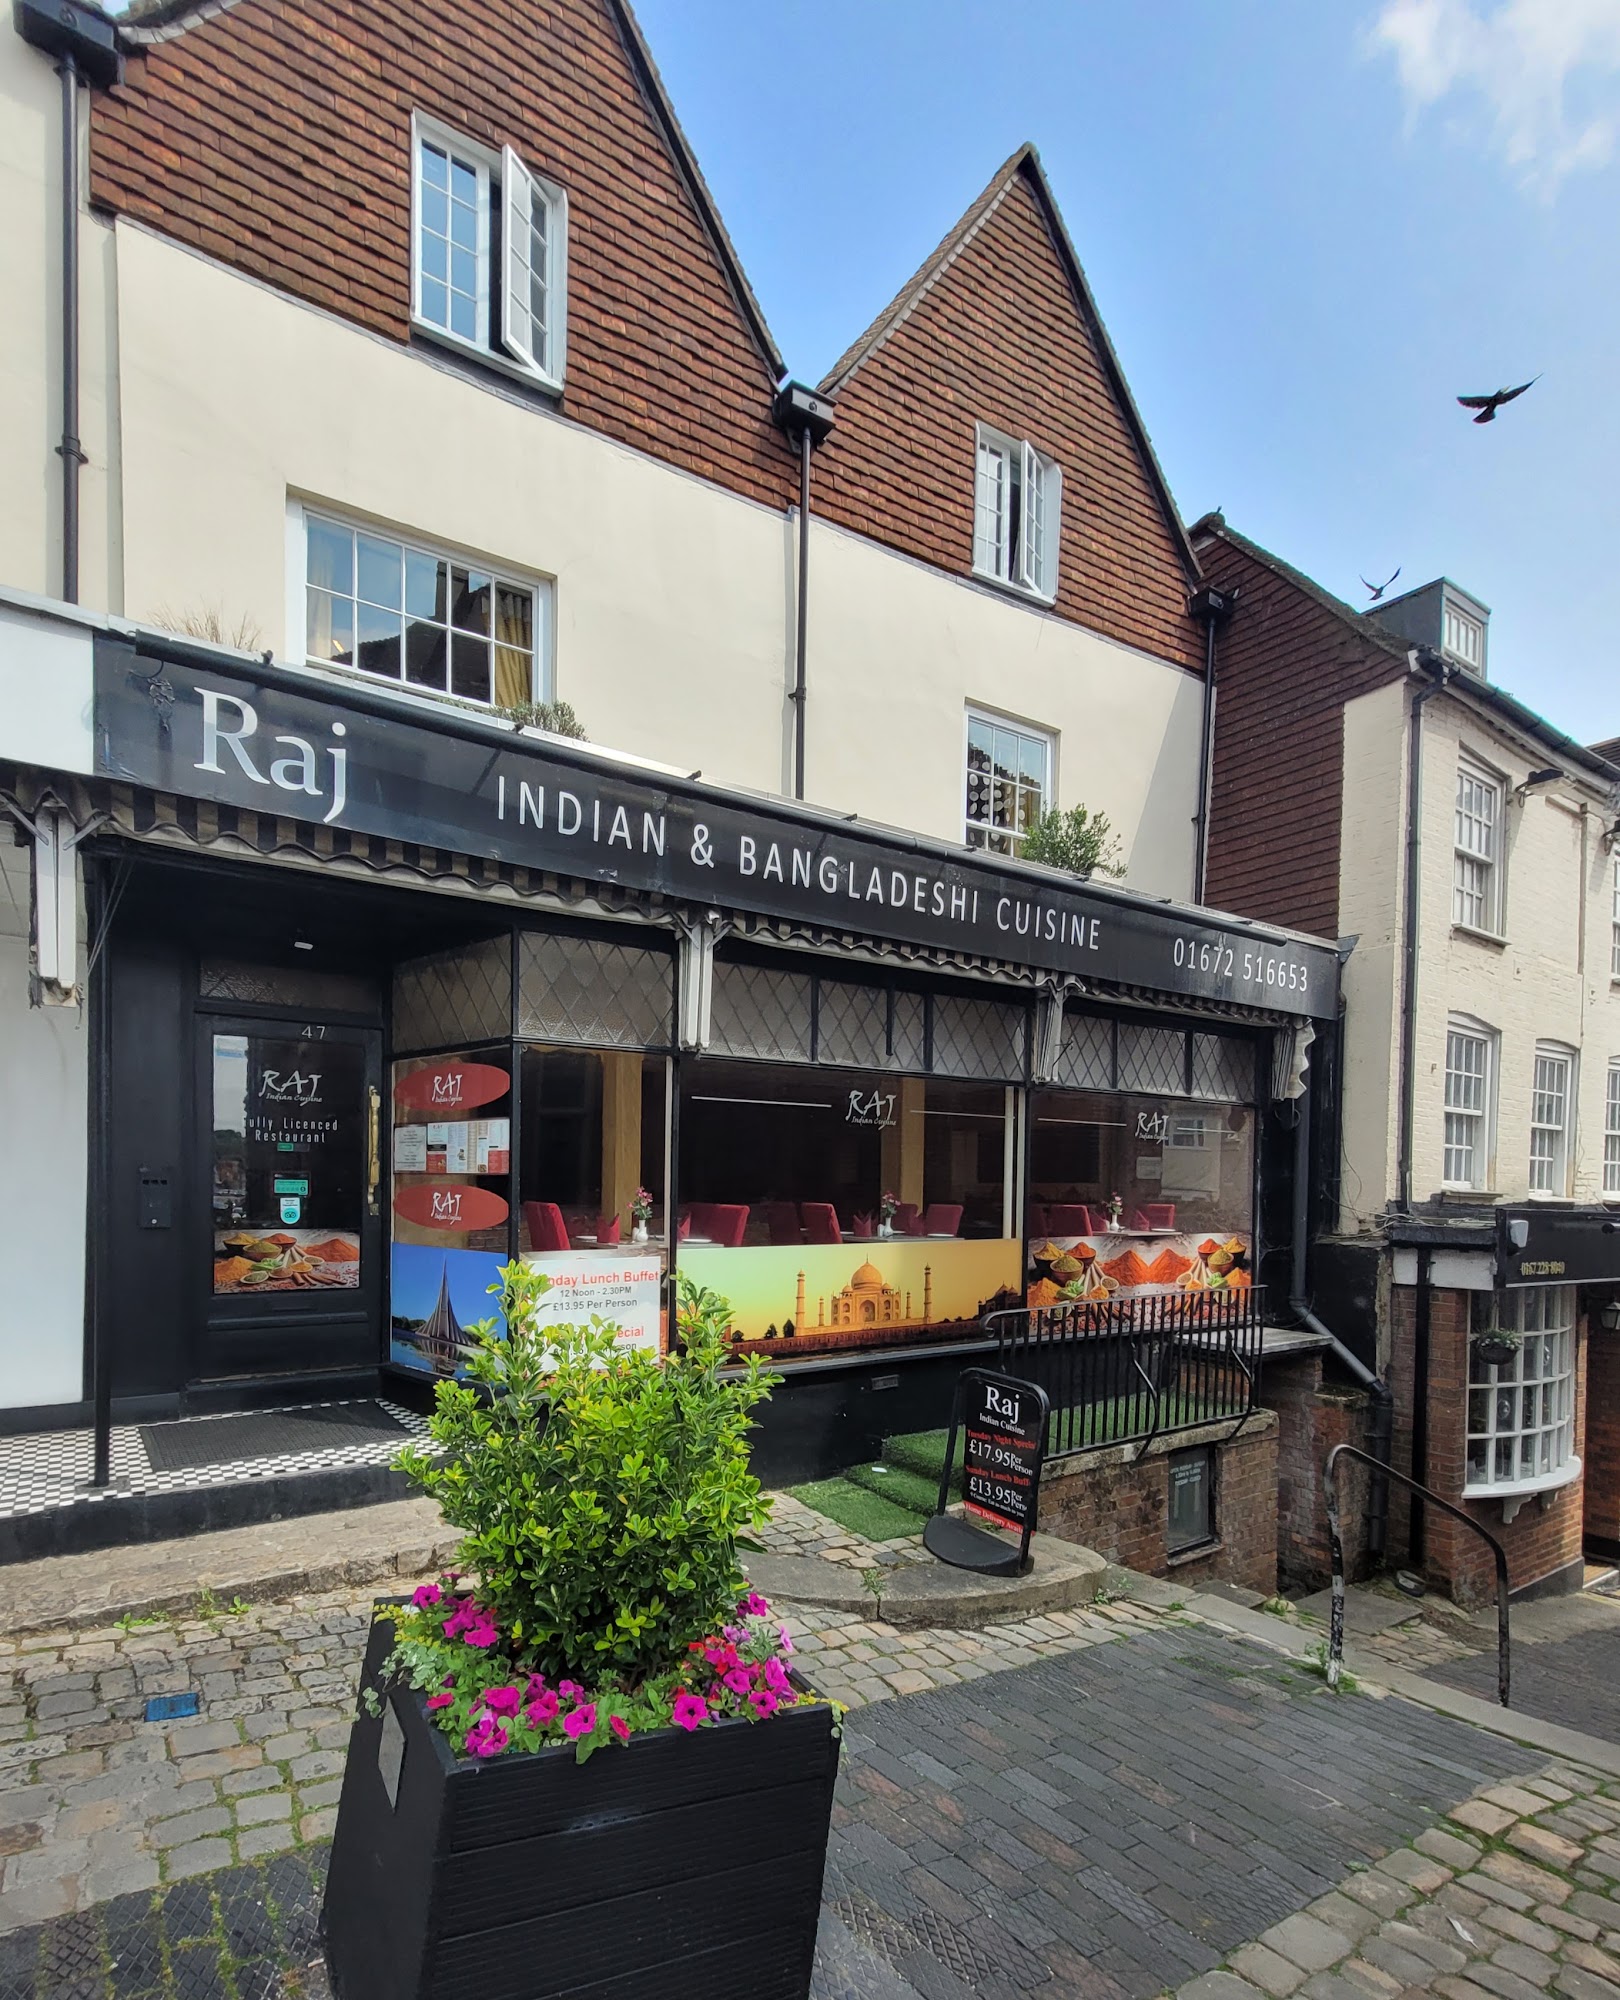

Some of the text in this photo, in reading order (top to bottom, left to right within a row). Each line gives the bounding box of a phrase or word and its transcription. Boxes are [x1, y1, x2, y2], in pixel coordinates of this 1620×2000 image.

[193, 686, 347, 824] Raj
[498, 775, 1101, 951] INDIAN & BANGLADESHI CUISINE
[1173, 937, 1308, 992] 01672 516653
[301, 1025, 326, 1040] 47
[258, 1070, 322, 1107] RAJ
[431, 1073, 463, 1106] RAJ
[845, 1090, 897, 1130] RAJ
[249, 1116, 338, 1131] ully Licenced
[255, 1129, 325, 1143] Restaurant
[1135, 1111, 1169, 1144] RAJ
[430, 1191, 462, 1226] RAJ
[548, 1270, 659, 1288] nday Lunch Buffet
[560, 1289, 569, 1298] 12
[572, 1288, 595, 1297] Noon
[602, 1286, 632, 1296] 2.30PM
[553, 1298, 638, 1311] £13.95 Per Person
[617, 1326, 644, 1338] ecial
[985, 1385, 1020, 1424] Raj
[979, 1412, 1026, 1436] Indian Cuisine
[968, 1438, 1023, 1467] £17.95 Per
[1010, 1461, 1033, 1476] Person
[1013, 1475, 1030, 1486] Buff
[969, 1476, 1023, 1504] £13.95 Per
[966, 1502, 982, 1516] Home
[982, 1509, 1005, 1527] Delivery
